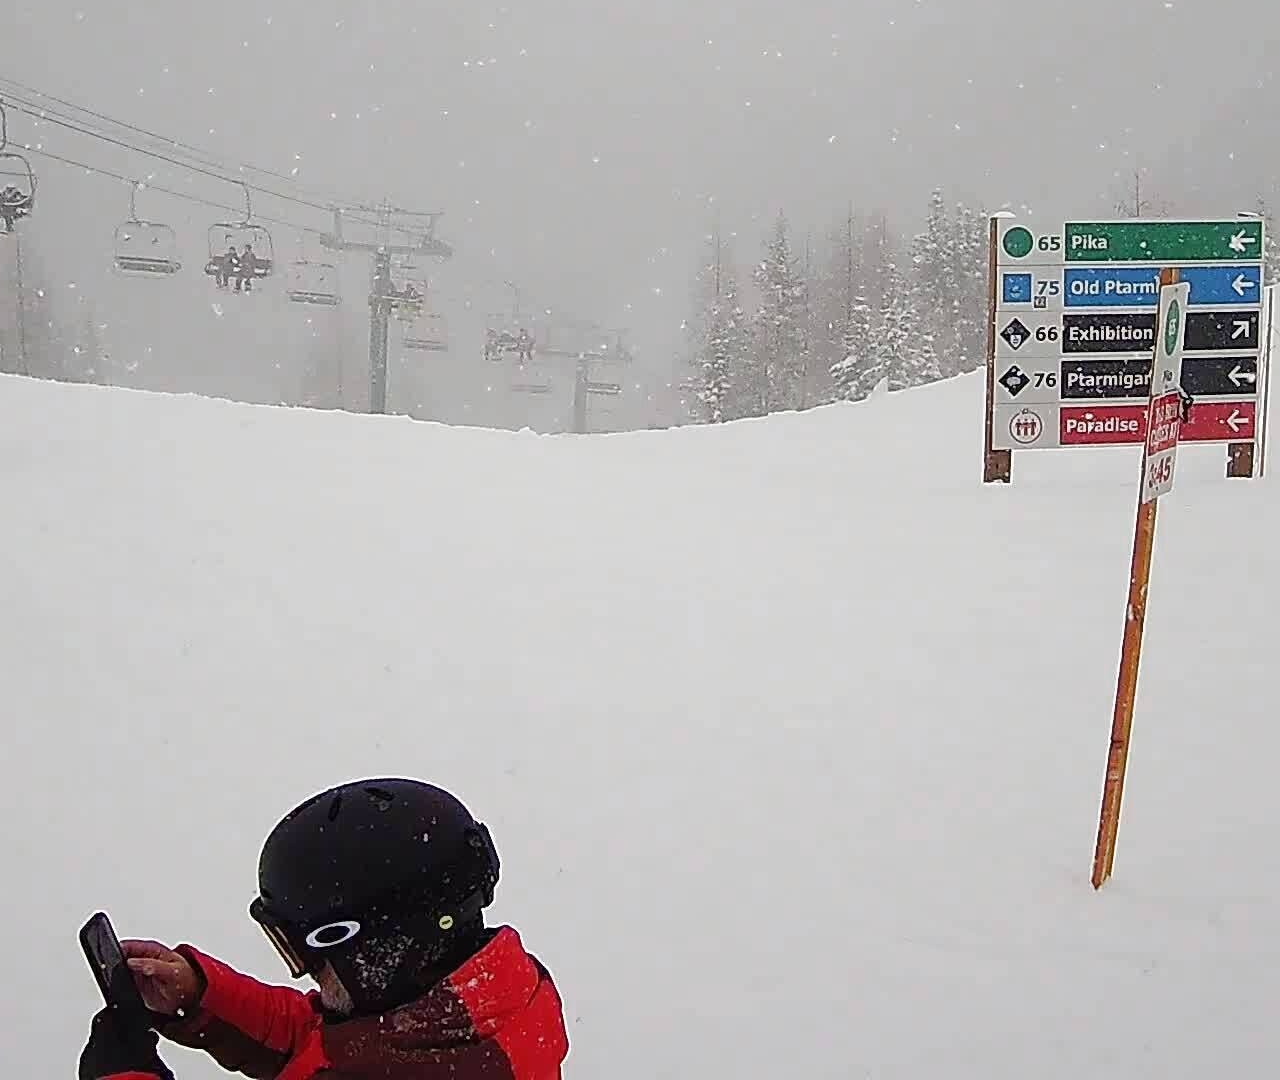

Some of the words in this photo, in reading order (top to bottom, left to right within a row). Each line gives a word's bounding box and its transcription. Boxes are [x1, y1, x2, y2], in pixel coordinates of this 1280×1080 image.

[1038, 235, 1061, 251] 65
[1071, 234, 1108, 250] Pika
[1037, 280, 1060, 296] 75
[1071, 279, 1100, 295] Old
[1035, 326, 1059, 341] 66
[1069, 325, 1153, 341] Exhibition
[1034, 372, 1057, 388] 76
[1066, 416, 1139, 434] Paradise
